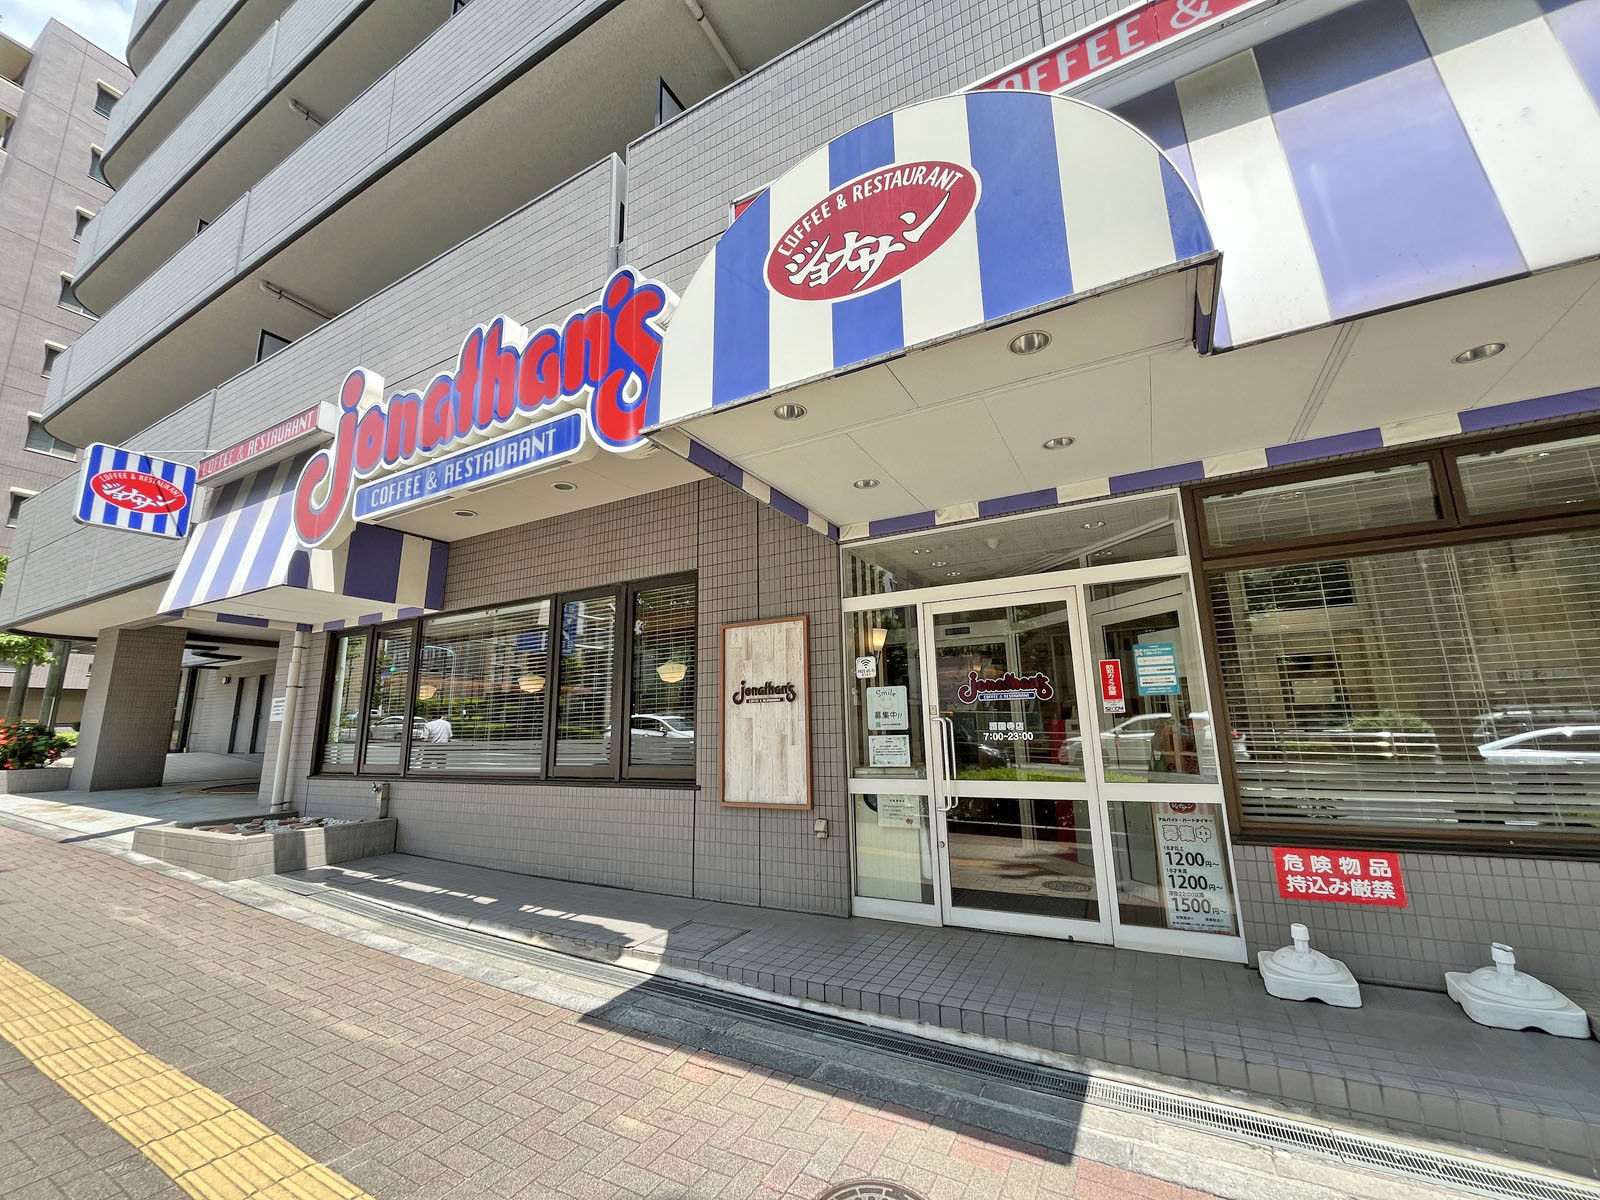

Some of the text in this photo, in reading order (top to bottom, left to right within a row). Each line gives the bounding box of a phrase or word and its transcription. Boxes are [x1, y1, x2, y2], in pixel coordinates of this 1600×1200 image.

[1170, 0, 1213, 29] &
[777, 165, 964, 256] COFFEE & RESTAURANT
[783, 190, 951, 291] ジョナサン
[295, 267, 664, 546] jonathan's
[202, 410, 314, 476] COFFEE & RESTAURANT
[371, 427, 558, 508] COFFEE & RESTAURANT
[99, 472, 181, 499] COFFEE & RESTAURANT
[102, 482, 176, 510] ジョナサン
[732, 680, 797, 705] jonathan's
[876, 688, 897, 697] Smile
[958, 670, 1054, 704] jonathan's
[1162, 824, 1212, 843] 募集中
[1282, 853, 1392, 878] 危険物品
[1285, 874, 1397, 900] 持込み厳禁
